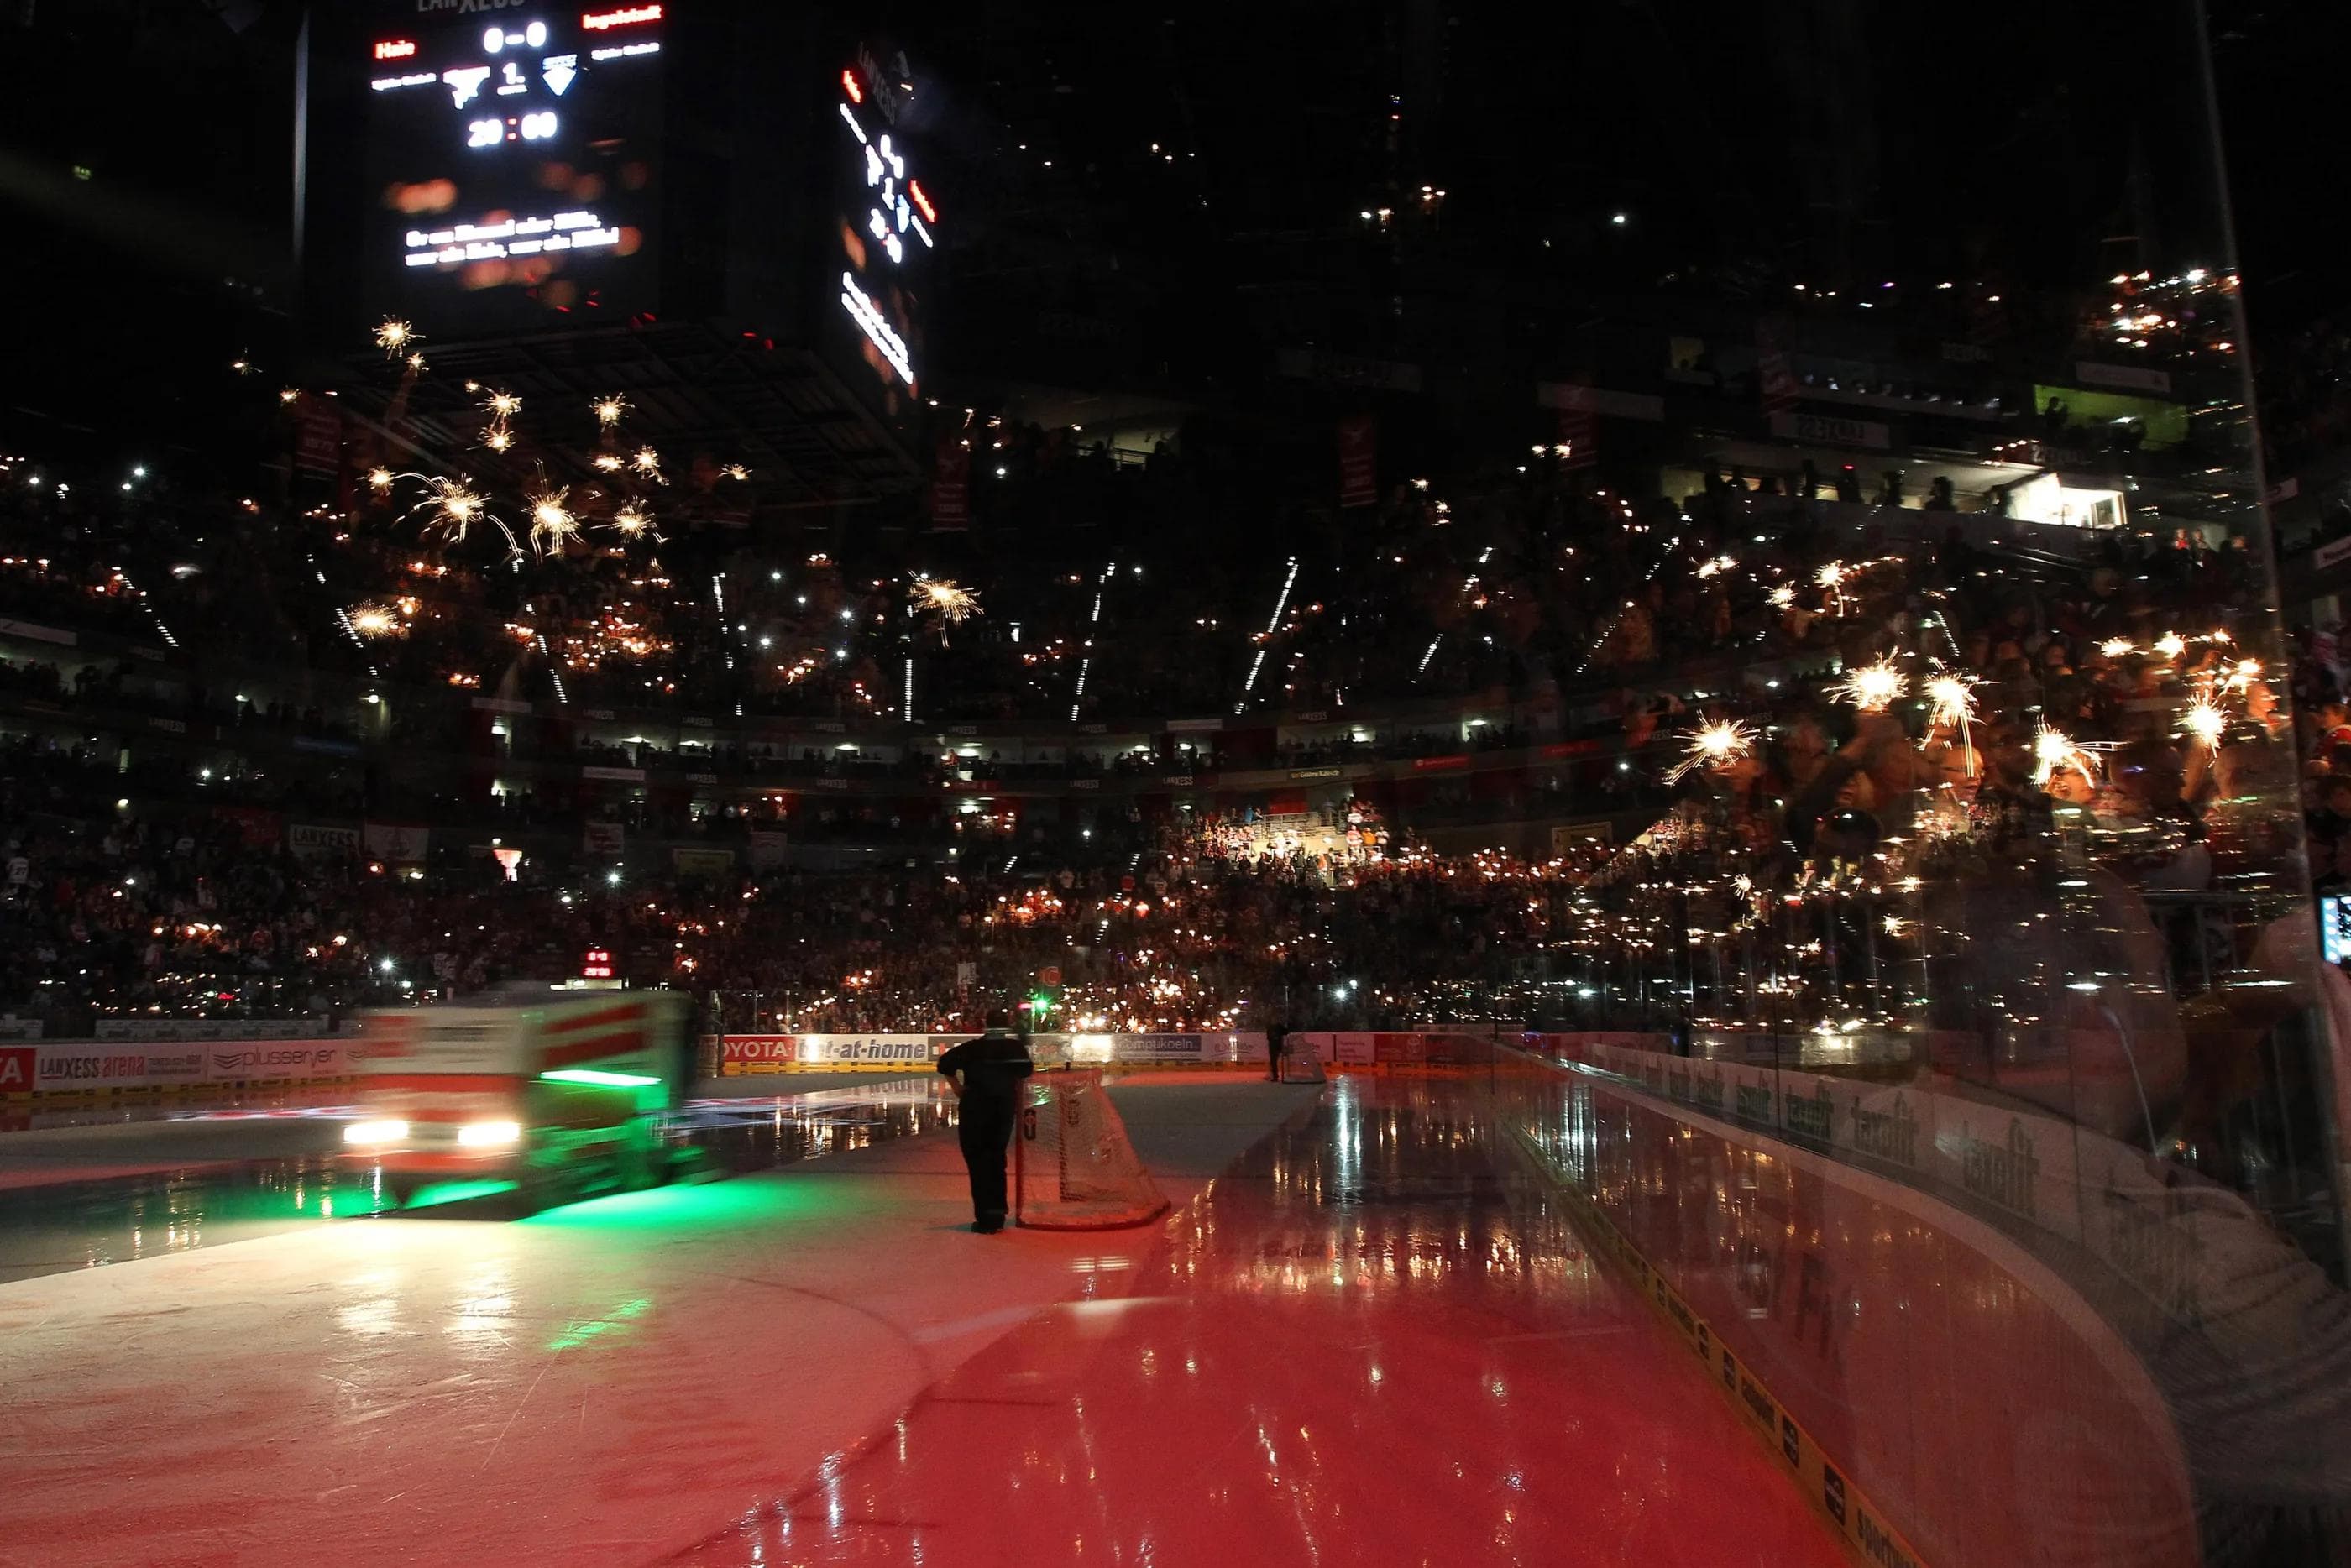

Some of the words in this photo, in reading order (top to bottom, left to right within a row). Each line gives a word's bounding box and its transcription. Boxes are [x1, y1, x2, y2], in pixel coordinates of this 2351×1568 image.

[375, 40, 415, 59] Haie
[294, 828, 354, 847] LANXESS
[799, 1039, 926, 1058] bt-at-home
[40, 1057, 100, 1079] LANXESS
[102, 1056, 145, 1077] arena
[243, 1049, 336, 1070] plusserver
[0, 1056, 23, 1084] A
